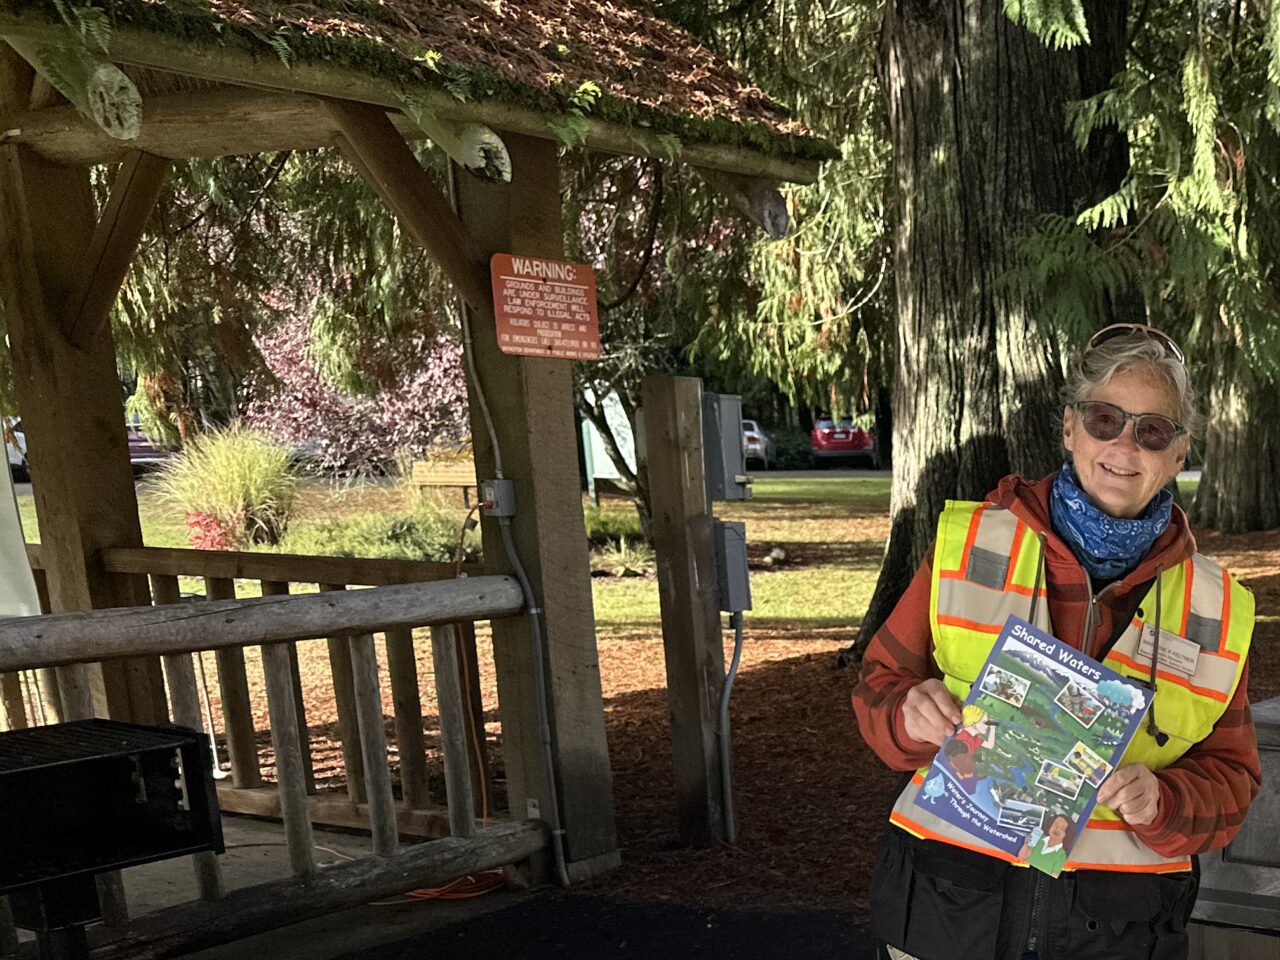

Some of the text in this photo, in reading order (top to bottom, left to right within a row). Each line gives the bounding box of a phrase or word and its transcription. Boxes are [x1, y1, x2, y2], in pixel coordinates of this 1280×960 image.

[512, 258, 576, 280] WARNING:
[505, 280, 535, 290] GROUNDS
[520, 290, 540, 298] UNDER
[504, 305, 533, 314] RESPOND
[537, 308, 544, 316] TO
[1012, 624, 1056, 655] Shared
[1058, 649, 1102, 680] Waters
[947, 781, 989, 822] Water's Journey
[950, 798, 1017, 843] Through the Watershed
